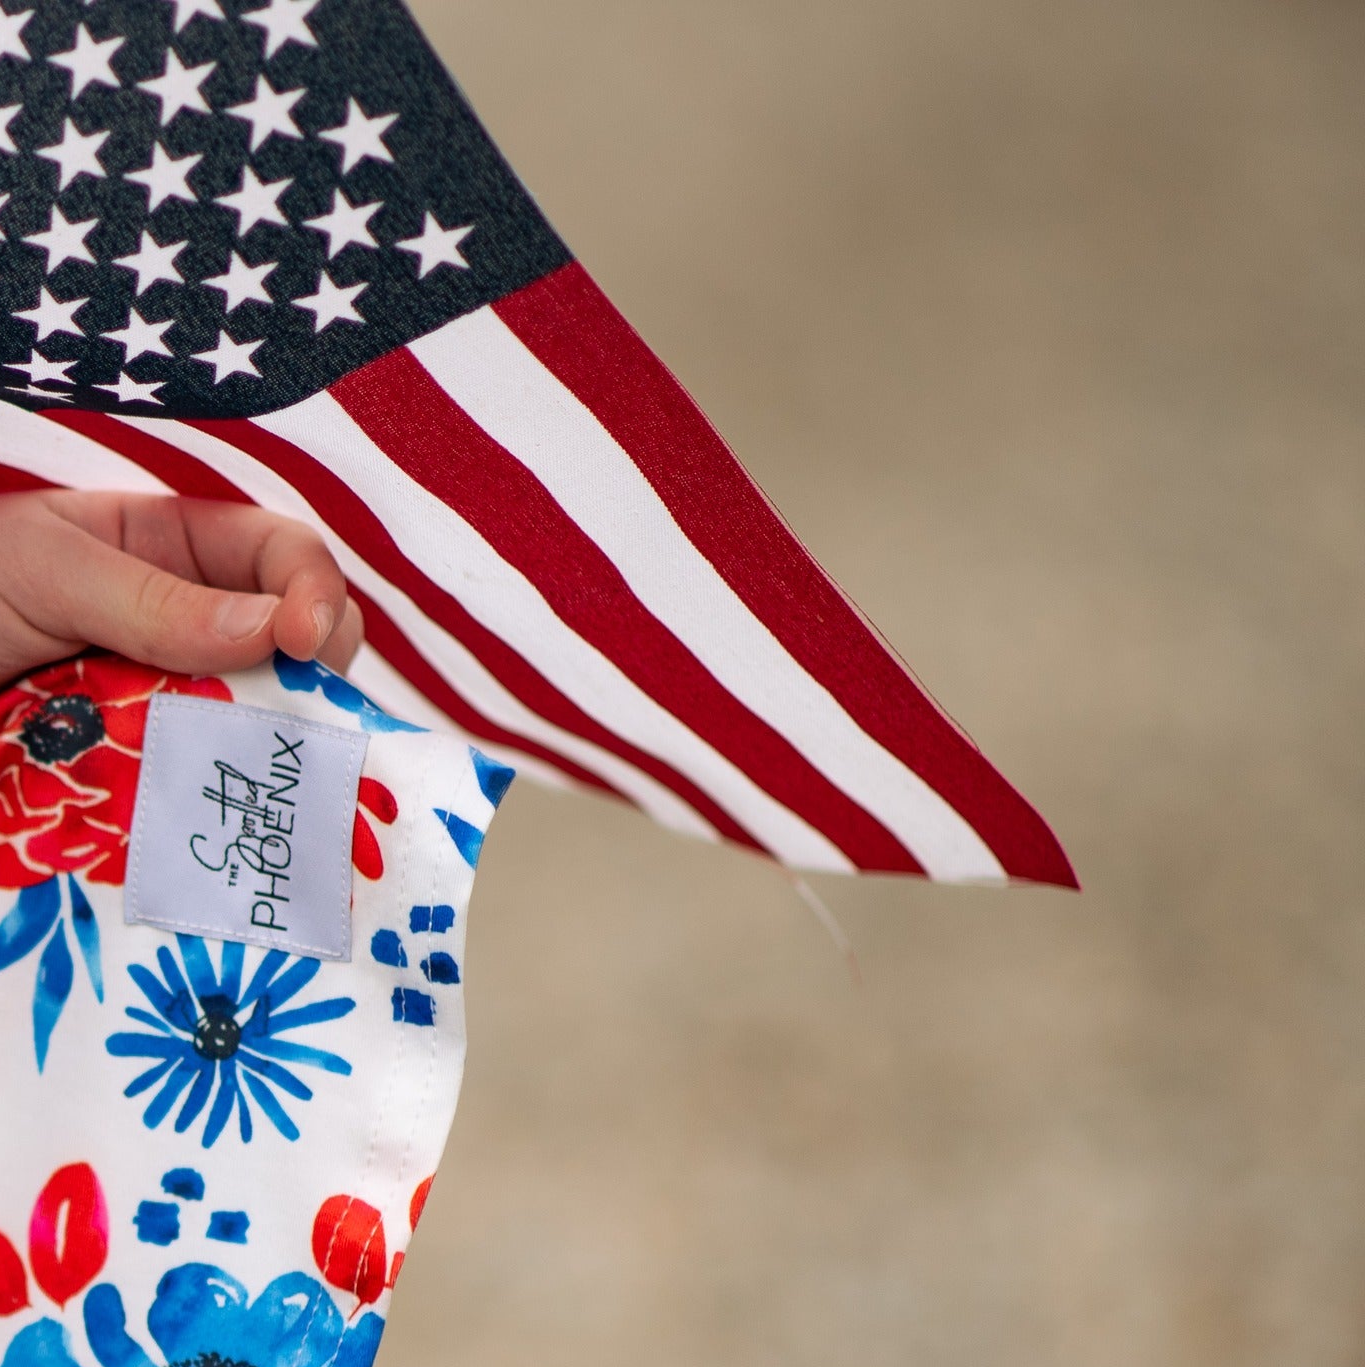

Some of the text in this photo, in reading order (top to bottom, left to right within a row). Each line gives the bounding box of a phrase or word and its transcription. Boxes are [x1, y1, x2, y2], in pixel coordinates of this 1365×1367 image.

[190, 760, 279, 887] THE Spotted
[251, 731, 304, 931] PHOENIX
